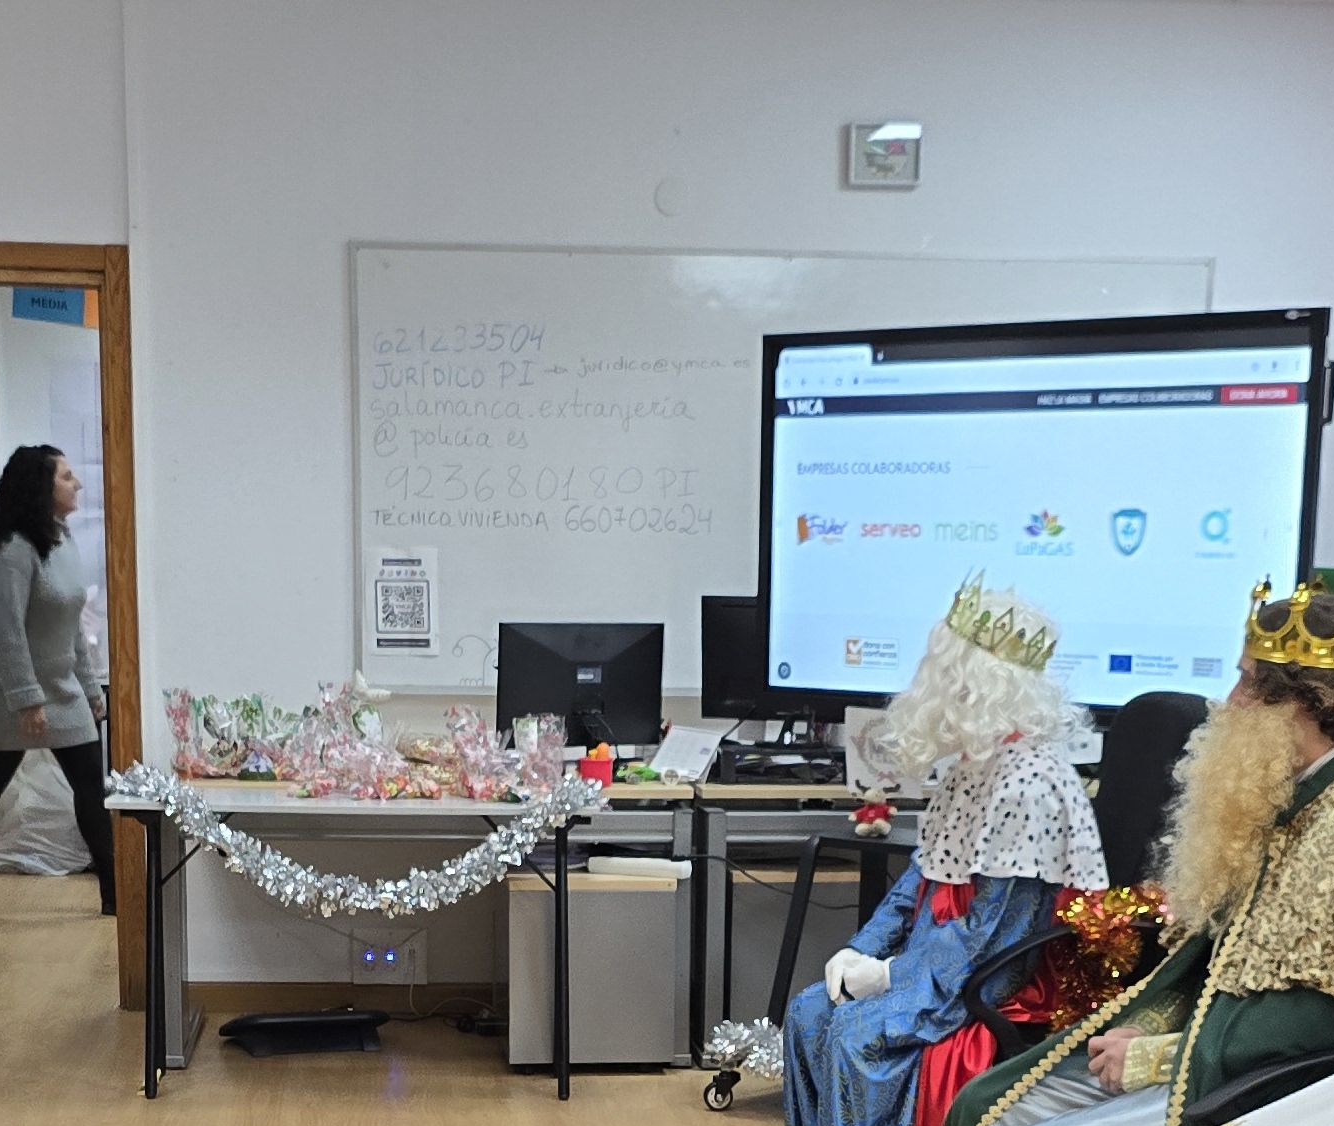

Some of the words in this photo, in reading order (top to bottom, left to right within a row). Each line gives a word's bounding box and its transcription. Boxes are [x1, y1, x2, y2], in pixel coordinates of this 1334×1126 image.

[30, 297, 68, 311] MEDIA
[373, 361, 485, 390] JURÍDICO
[498, 360, 535, 388] PI
[796, 462, 849, 476] EMPRESAS
[850, 461, 952, 475] COLABORADORAS
[370, 505, 453, 527] TÉCNICO
[457, 509, 549, 531] VIVIENDA
[564, 503, 713, 536] 660702624
[859, 521, 922, 538] serveo
[934, 518, 999, 543] meins
